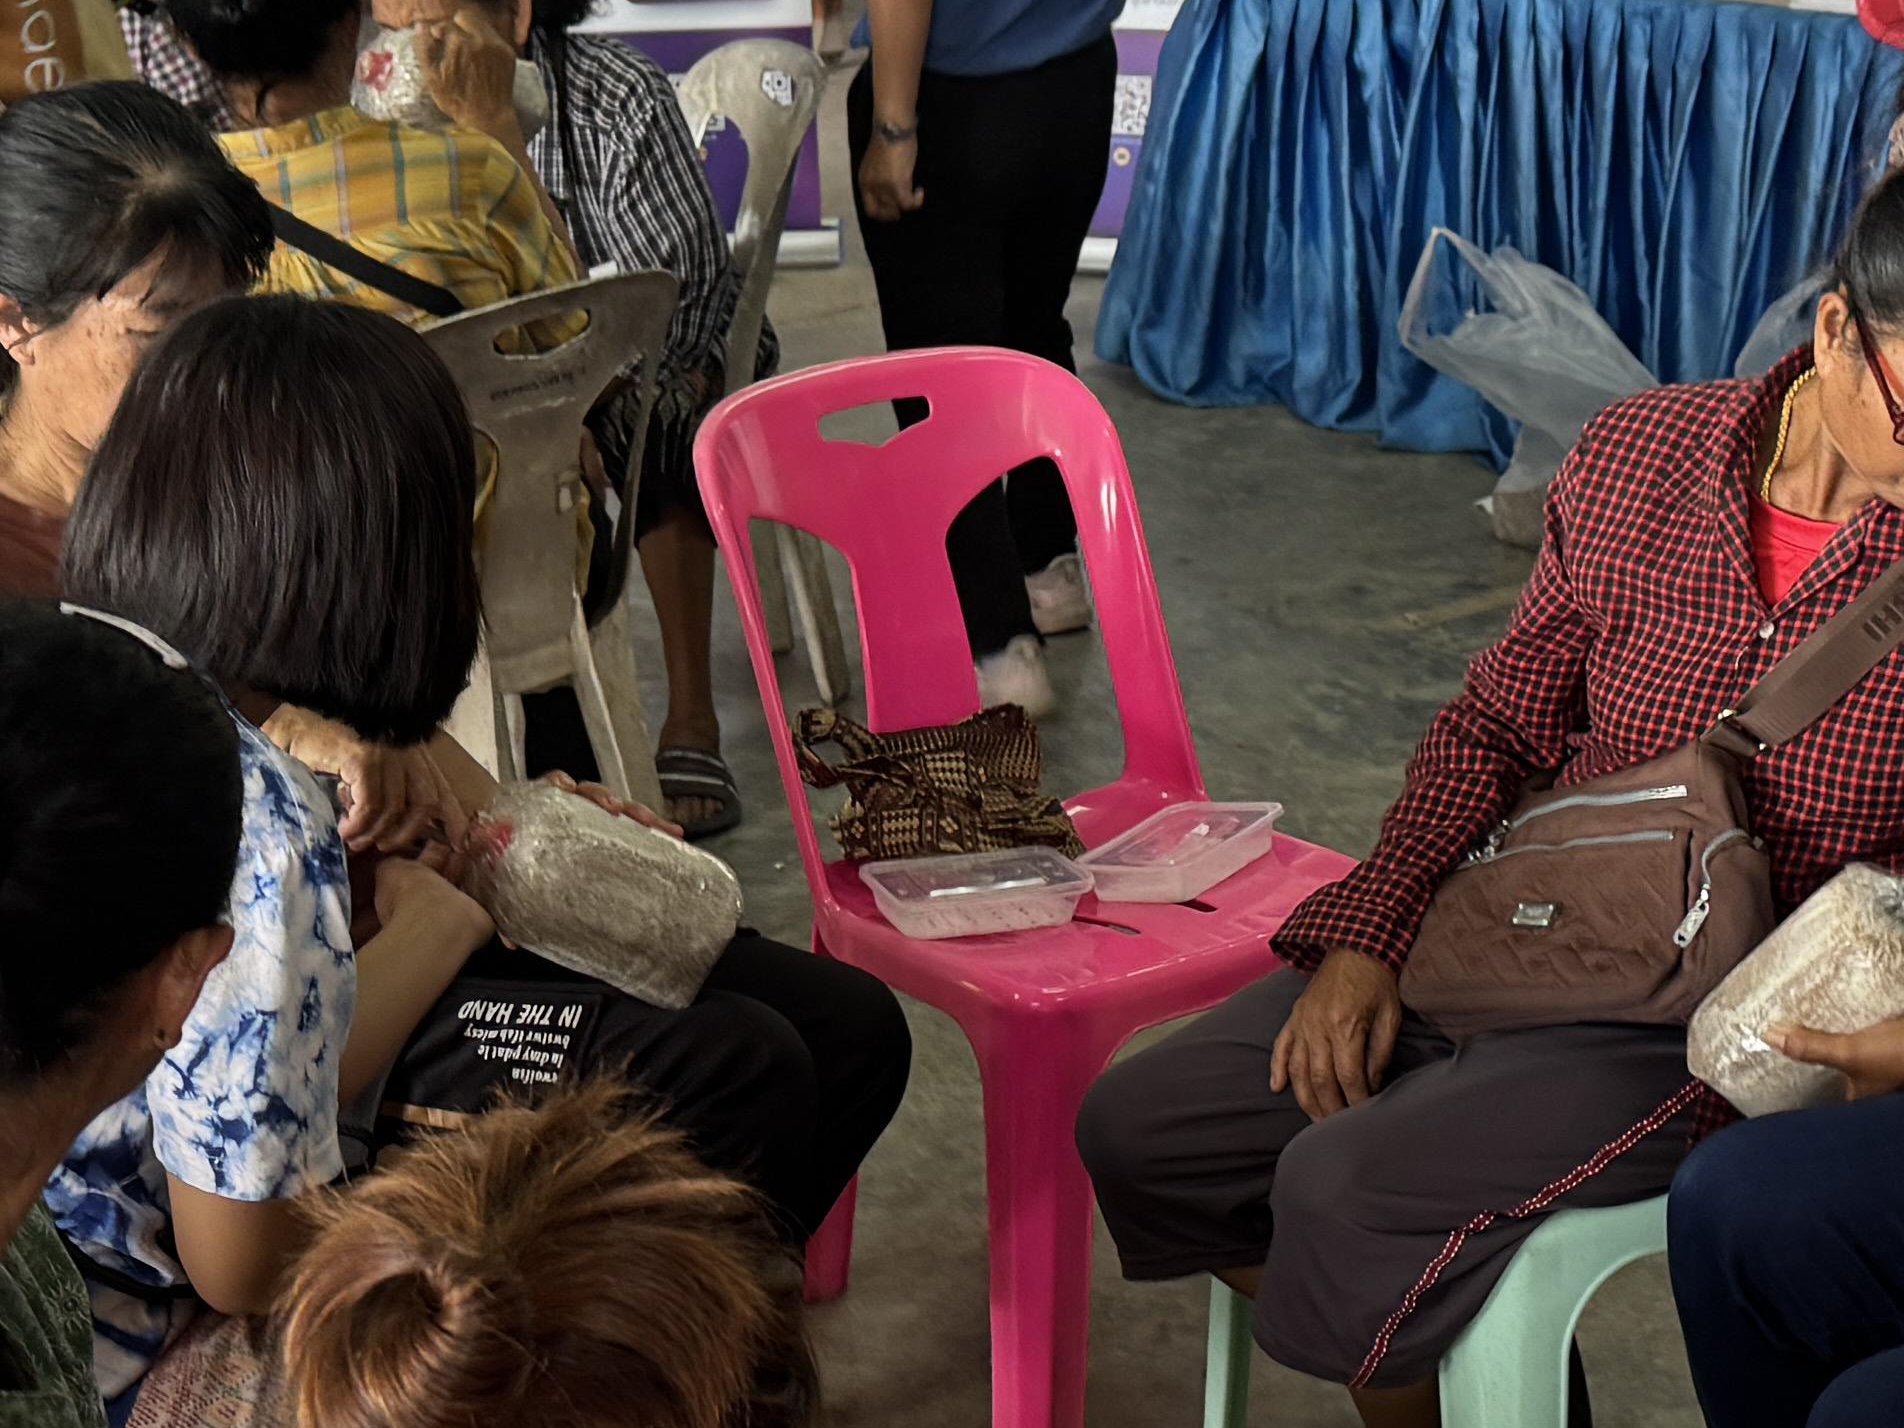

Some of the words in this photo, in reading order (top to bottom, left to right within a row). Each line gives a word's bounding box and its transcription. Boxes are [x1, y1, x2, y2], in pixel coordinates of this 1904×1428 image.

[458, 1000, 514, 1024] HAND
[516, 1004, 554, 1025] THE
[558, 1004, 583, 1029] IN
